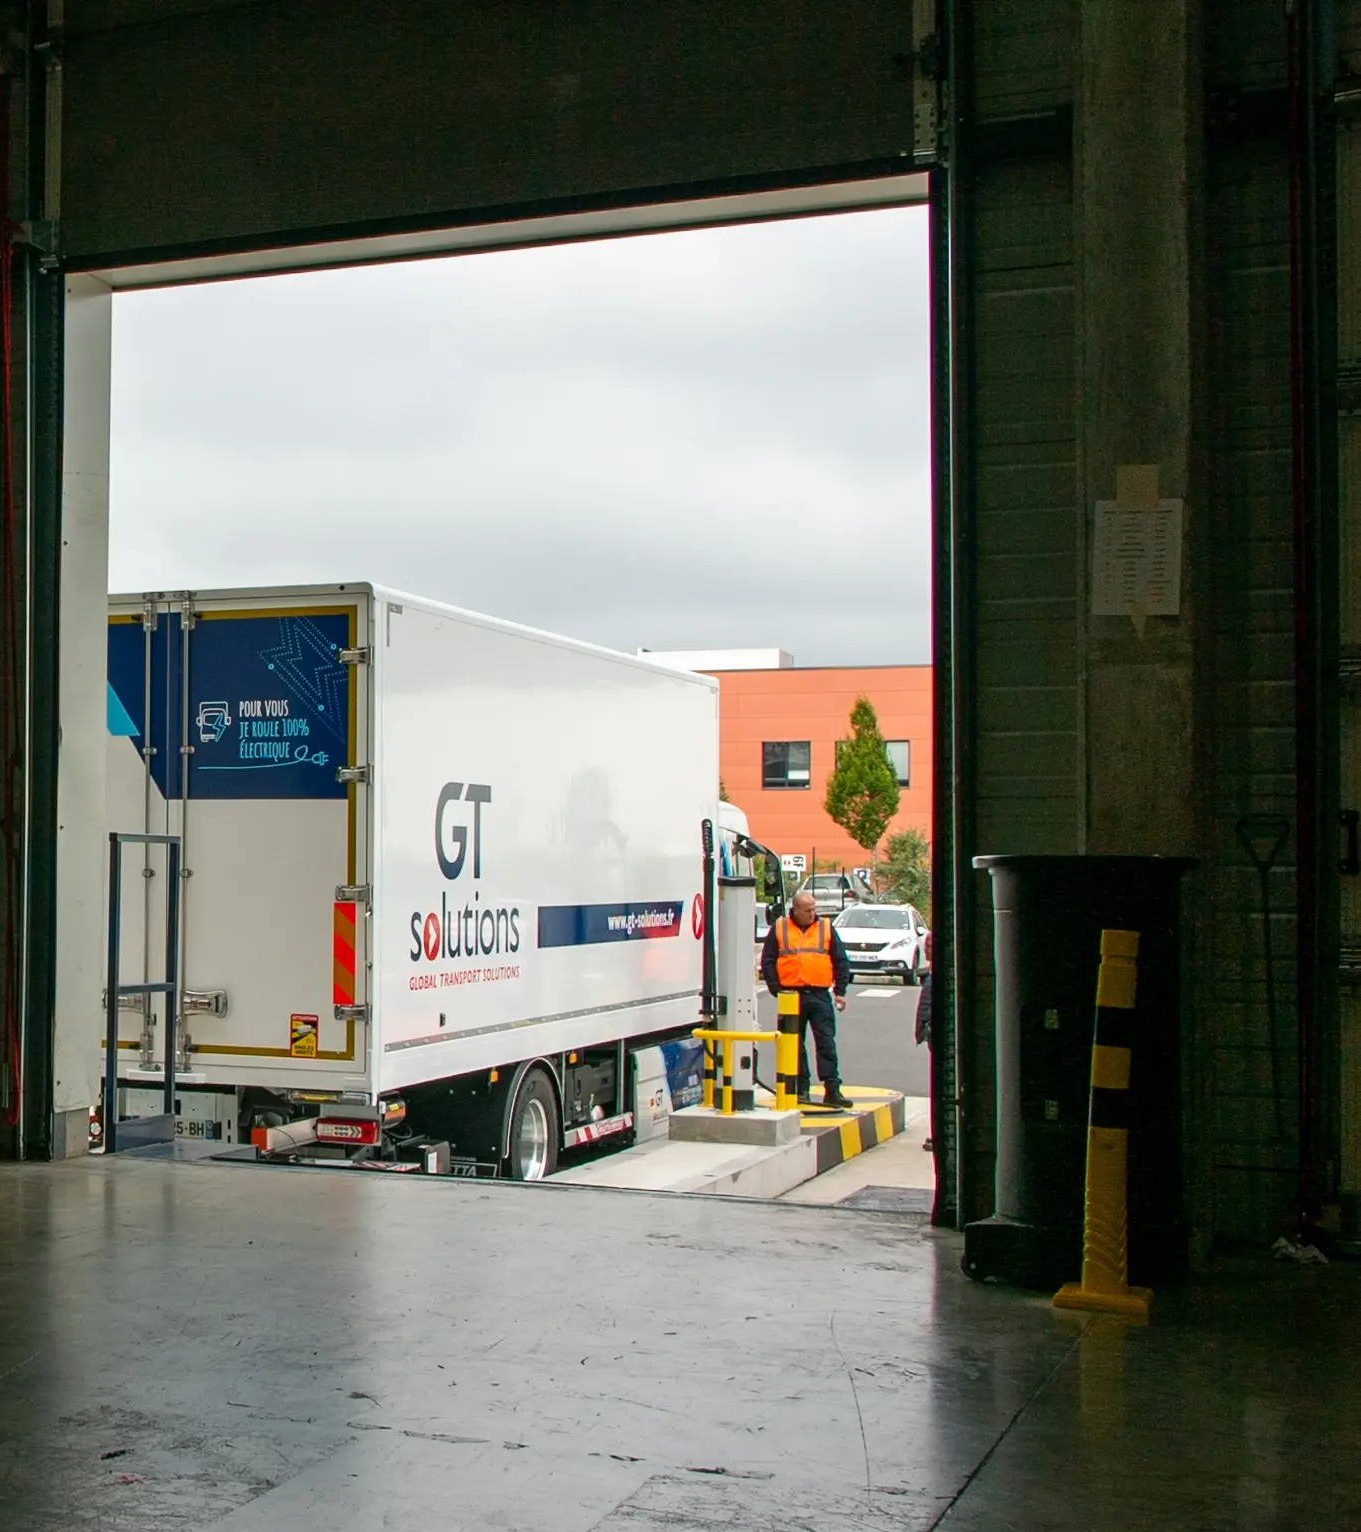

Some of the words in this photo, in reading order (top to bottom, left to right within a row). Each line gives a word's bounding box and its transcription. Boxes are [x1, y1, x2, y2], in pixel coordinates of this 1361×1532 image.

[239, 701, 262, 717] POUR
[265, 700, 288, 716] VOUS
[239, 721, 249, 739] JE
[252, 720, 279, 737] ROULE
[282, 718, 309, 736] 100%
[240, 740, 290, 762] ÉLECTRIQUE
[435, 781, 492, 880] GT
[410, 891, 520, 962] solutions
[607, 908, 675, 934] www.gt-solutions.fr
[409, 974, 437, 990] GLOBAL
[440, 969, 481, 987] TRANSPORT
[483, 965, 520, 982] SOLUTIONS
